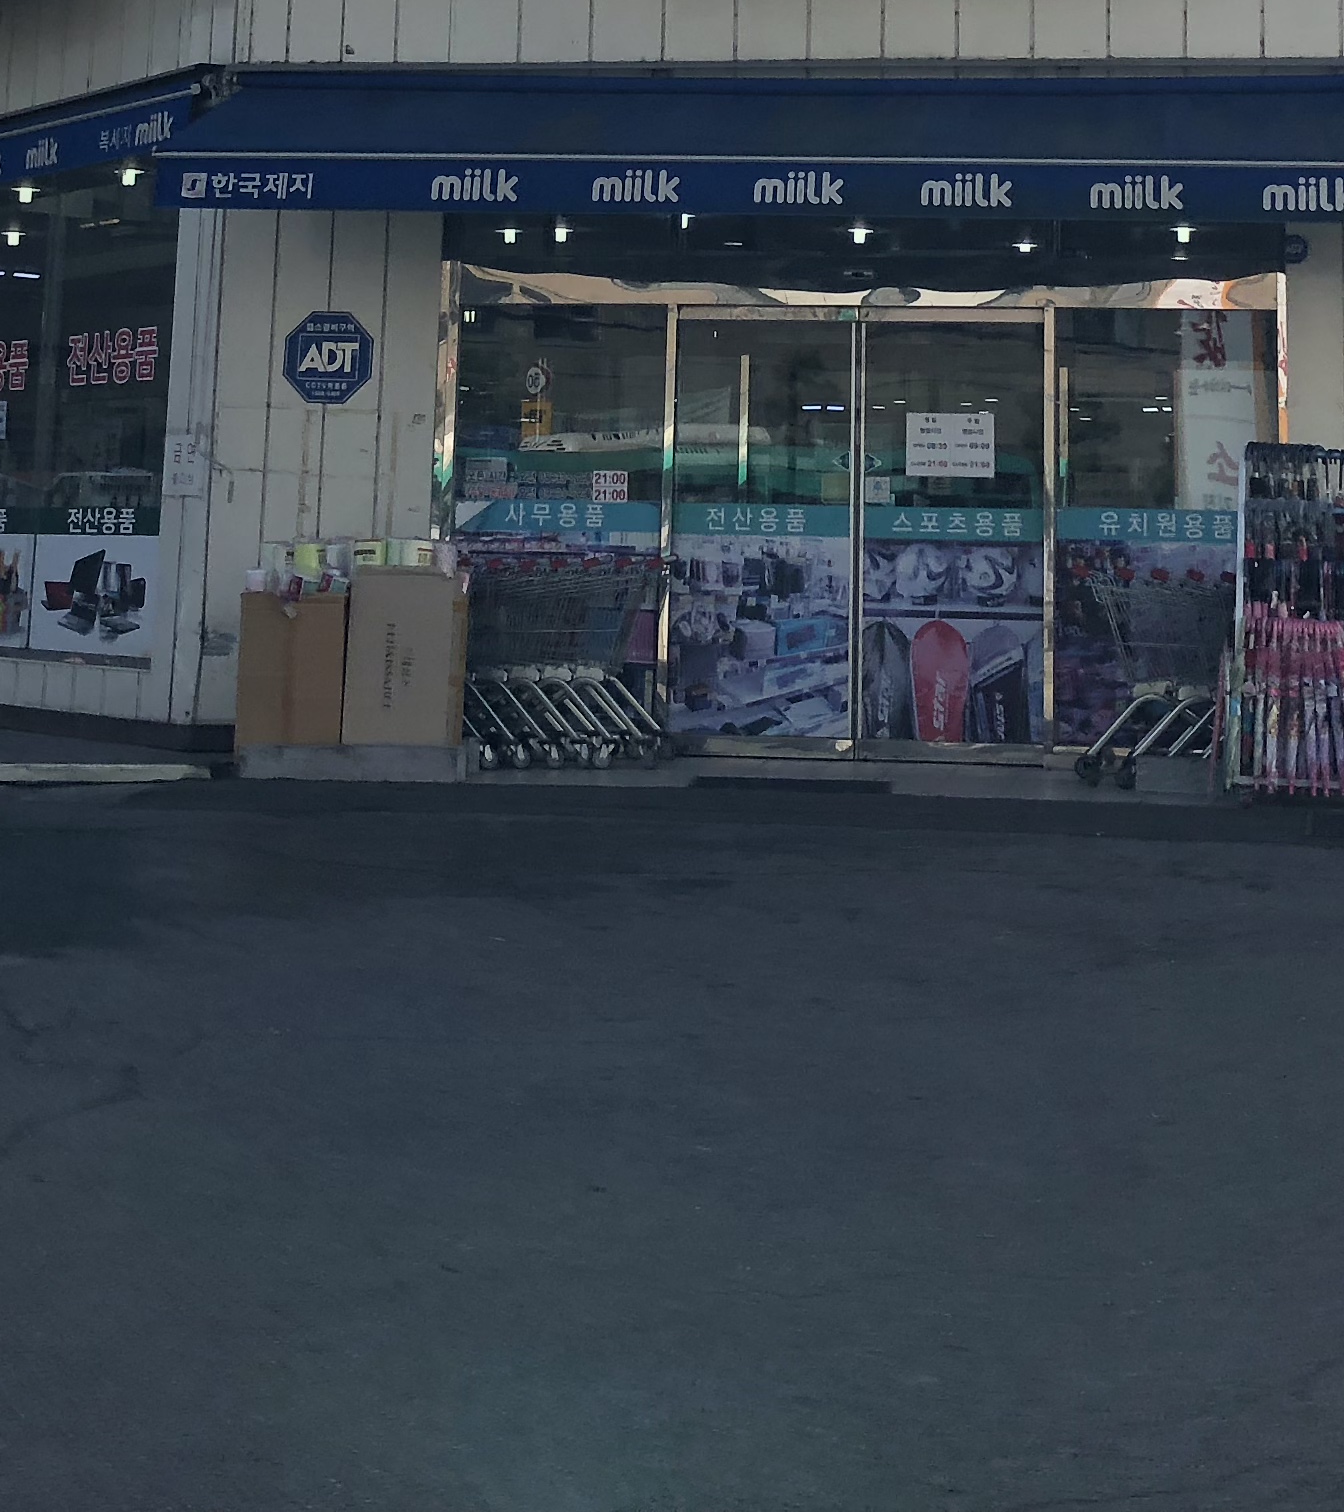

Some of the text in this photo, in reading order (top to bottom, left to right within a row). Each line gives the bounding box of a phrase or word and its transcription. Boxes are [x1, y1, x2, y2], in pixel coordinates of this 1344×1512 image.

[211, 171, 315, 200] 한국제지
[430, 167, 520, 203] miilk
[591, 168, 681, 204] miilk
[753, 169, 845, 205] miilk
[920, 172, 1014, 208] miilk
[1089, 174, 1185, 211] miilk
[67, 326, 159, 386] 전산용품
[299, 341, 359, 373] ADT
[594, 470, 628, 486] 21:00
[594, 486, 628, 503] 21:00
[67, 508, 137, 535] 전산용품
[505, 502, 606, 528] 사무용품
[705, 506, 807, 532] 전산용품
[891, 510, 1024, 537] 스포츠용품
